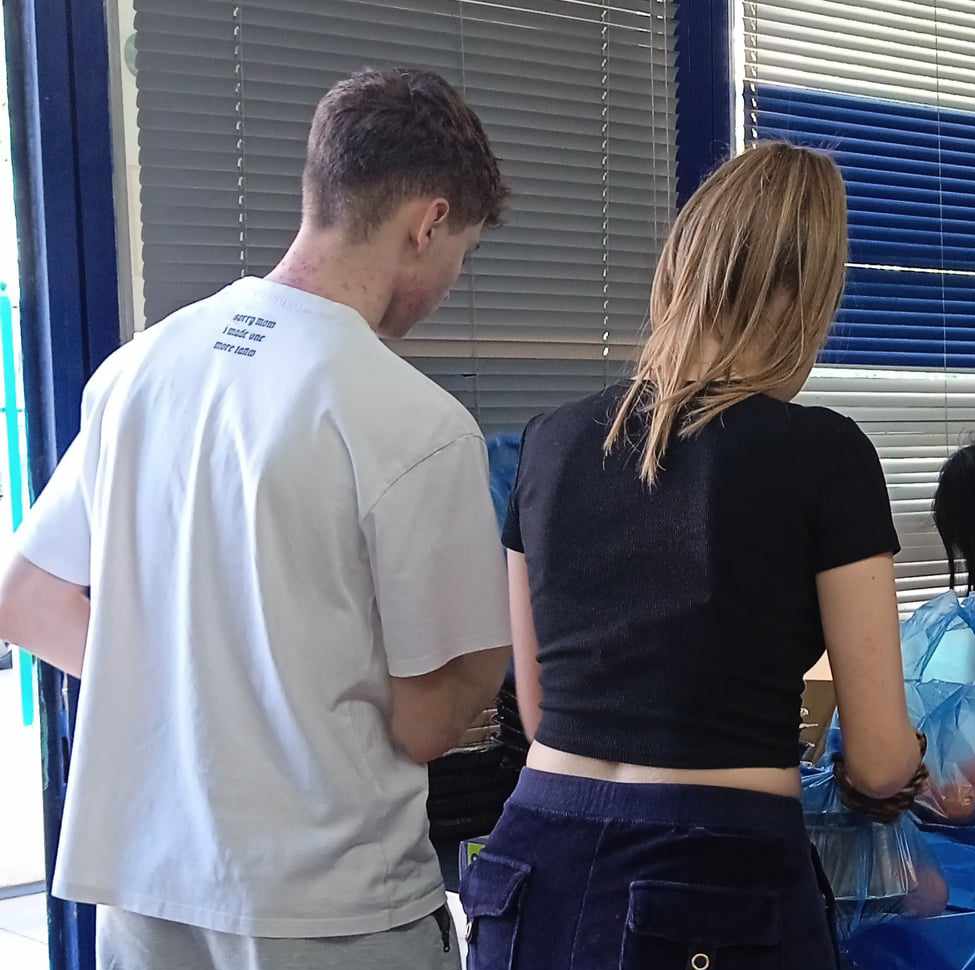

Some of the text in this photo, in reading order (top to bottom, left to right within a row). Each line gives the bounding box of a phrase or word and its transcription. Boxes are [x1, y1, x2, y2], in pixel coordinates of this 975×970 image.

[255, 317, 277, 329] mom
[227, 327, 249, 339] made
[248, 333, 266, 342] one
[213, 341, 235, 353] more
